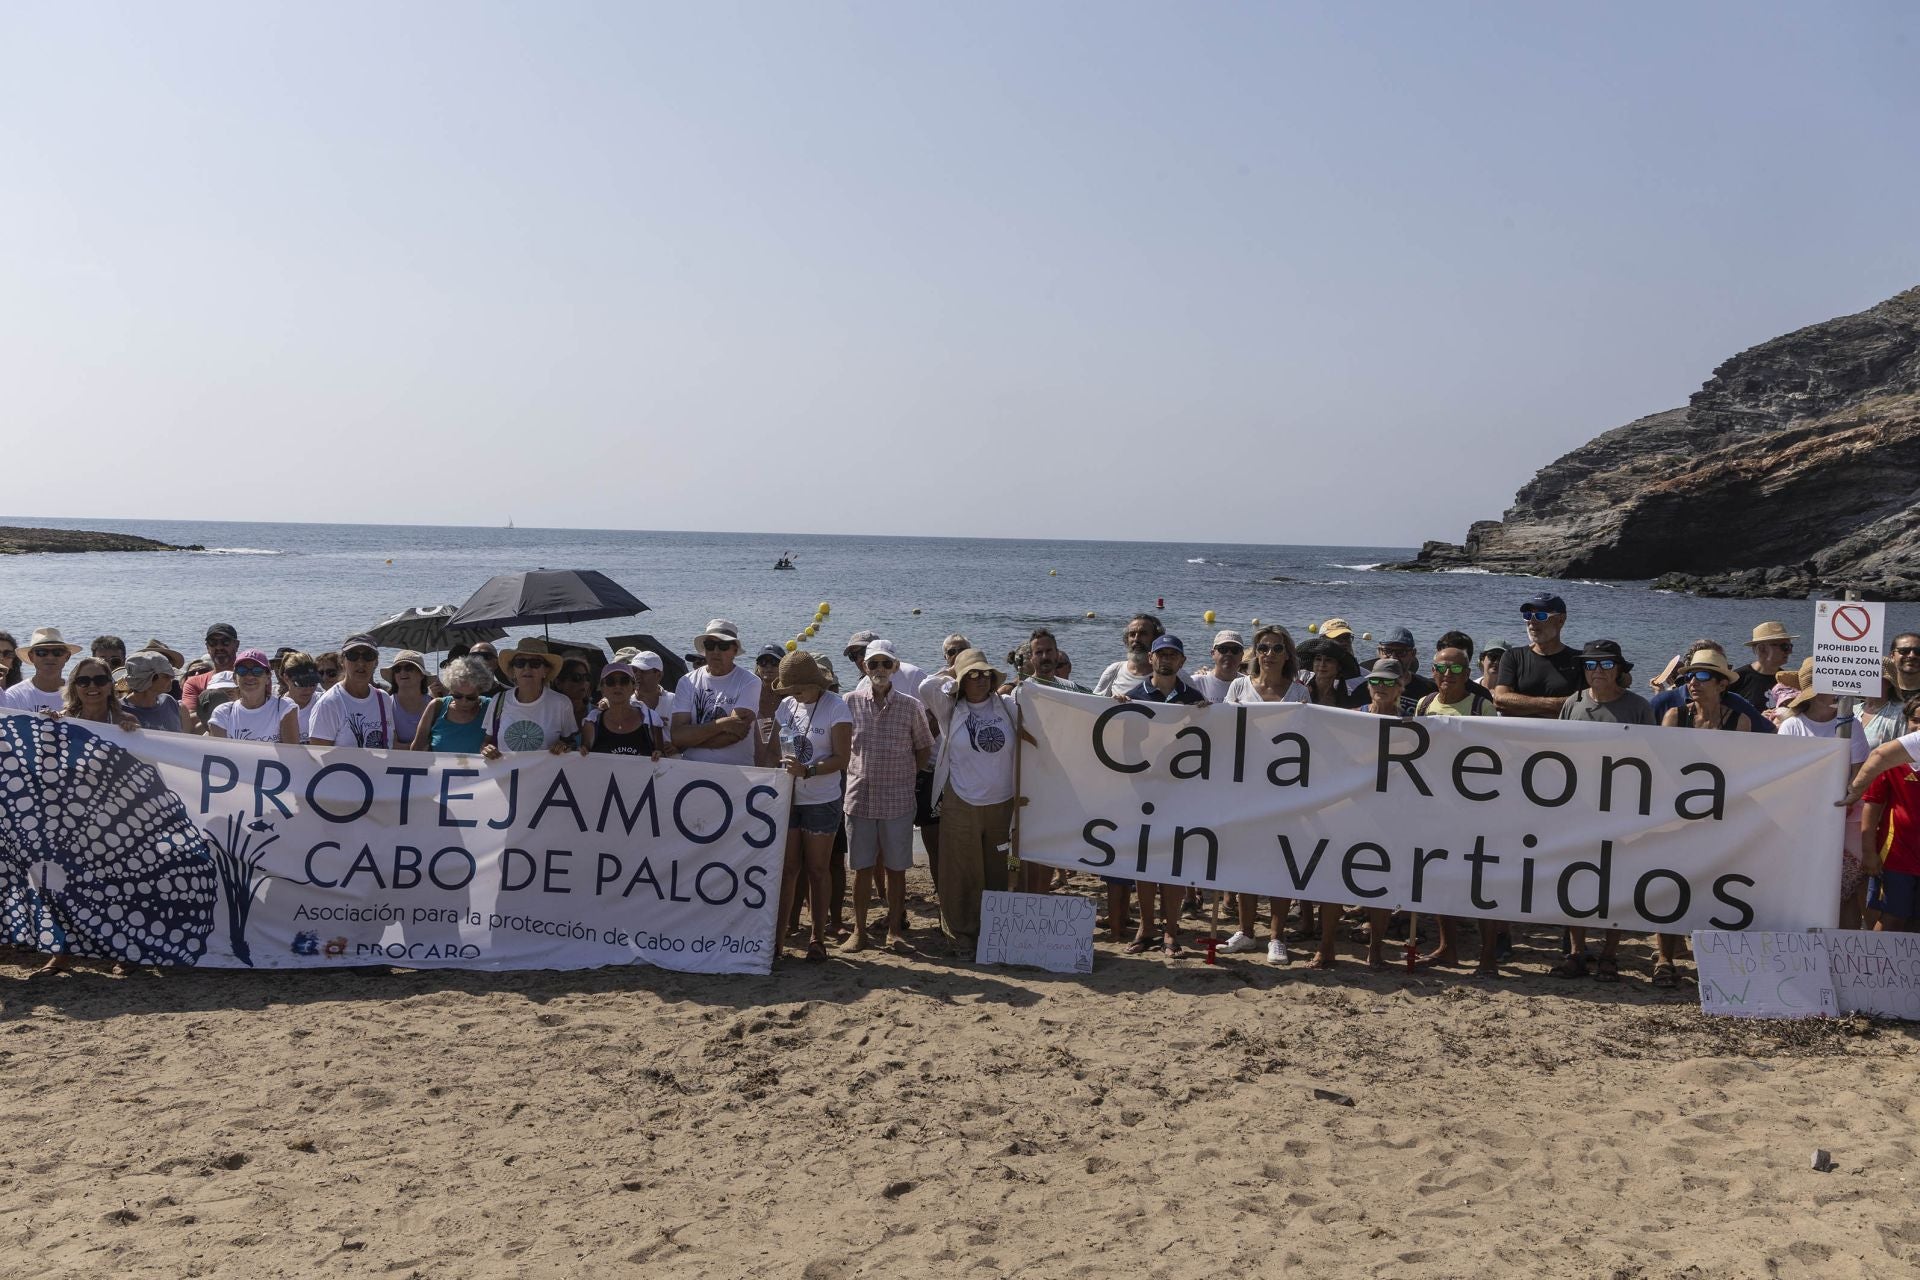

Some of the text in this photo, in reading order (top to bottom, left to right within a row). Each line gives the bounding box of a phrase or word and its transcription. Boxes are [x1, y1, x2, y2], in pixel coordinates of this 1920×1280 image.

[1817, 643, 1880, 653] PROHIBIDO EL
[1815, 654, 1881, 666] BAÑO EN ZONA
[1815, 667, 1880, 678] ACOTADA CON
[1832, 680, 1862, 689] BOYAS
[1092, 703, 1726, 821] Cala Reona
[200, 754, 779, 849] PROTEJAMOS
[304, 841, 768, 909] CABO DE PALOS
[1078, 802, 1756, 931] sin vertidos
[985, 895, 1093, 920] QUEREMOS
[293, 903, 764, 954] Asociación para la protección de Cabo de Palos
[991, 914, 1077, 936] BAÑARNOS
[987, 932, 1008, 948] EN
[1076, 937, 1093, 953] NO
[1699, 931, 1825, 955] CALA REONA
[1844, 935, 1888, 956] CALA
[986, 947, 1007, 963] EN
[1727, 953, 1817, 975] NO ES UN
